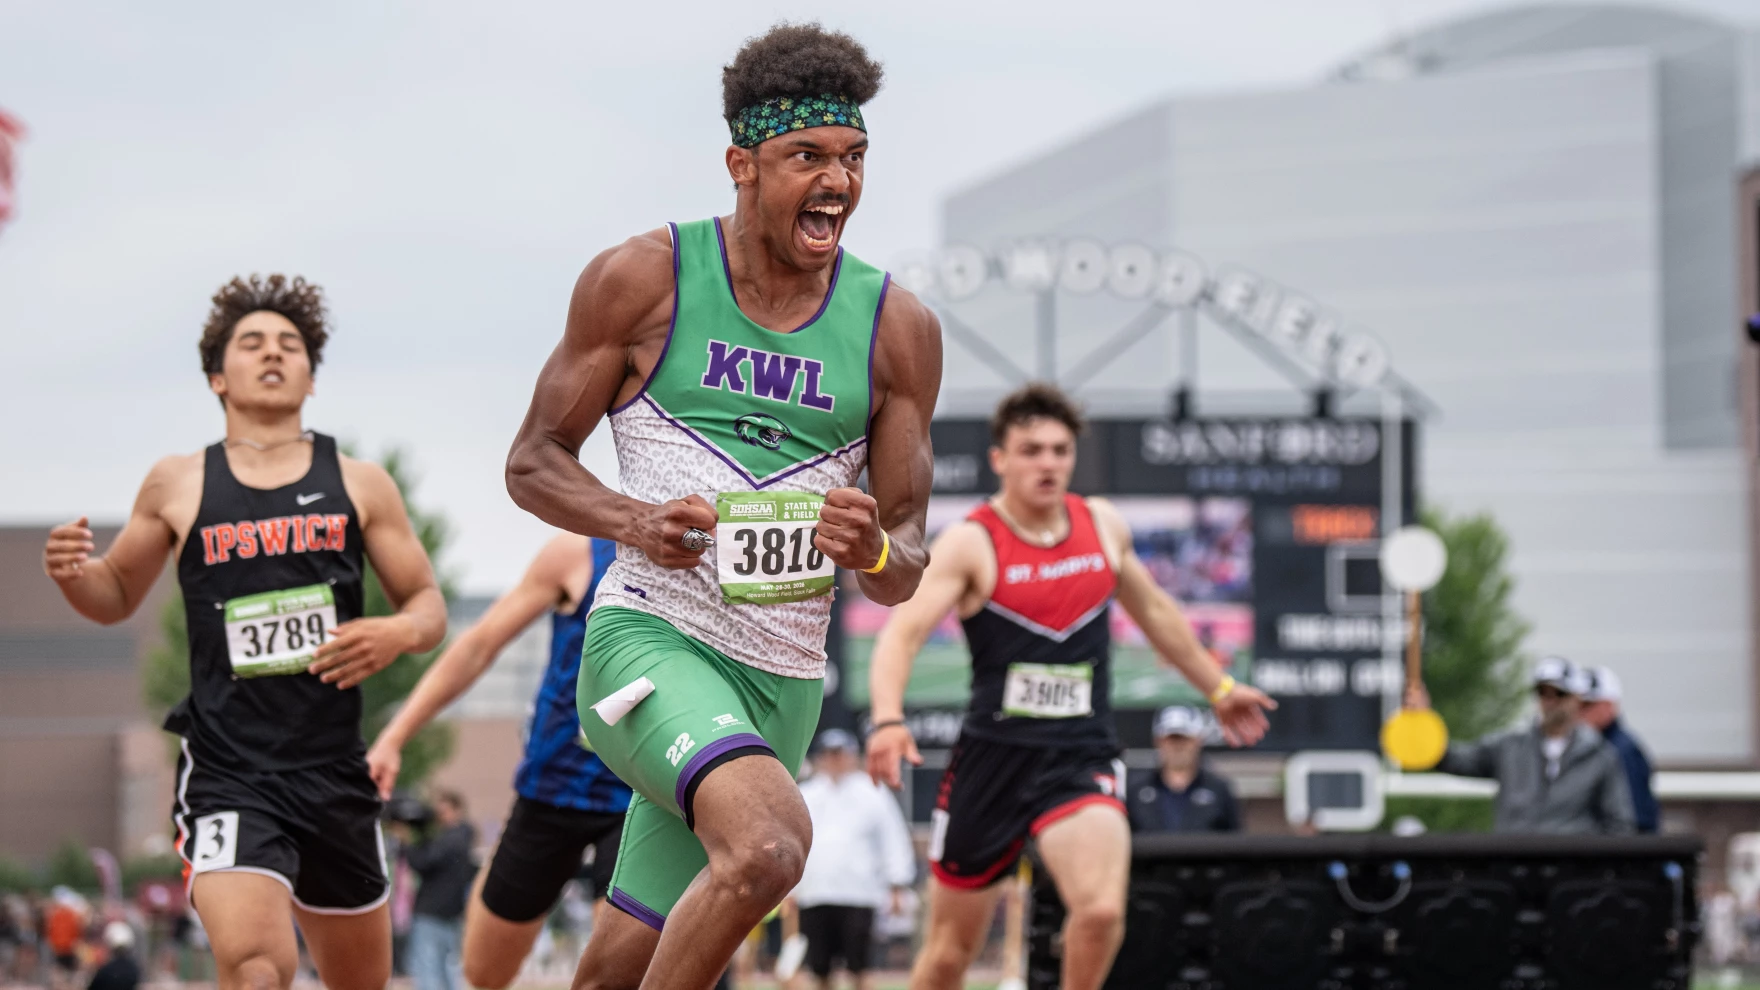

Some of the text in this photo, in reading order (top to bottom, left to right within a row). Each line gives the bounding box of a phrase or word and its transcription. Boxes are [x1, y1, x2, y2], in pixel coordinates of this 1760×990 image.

[700, 339, 835, 413] KWL
[783, 511, 790, 519] &
[793, 511, 814, 519] FIELD
[784, 502, 808, 510] STATE
[200, 513, 349, 566] IPSWICH
[734, 528, 825, 576] 3818
[241, 613, 324, 657] 3789
[1020, 678, 1079, 706] 3905
[665, 732, 696, 767] 22
[202, 818, 225, 860] 3
